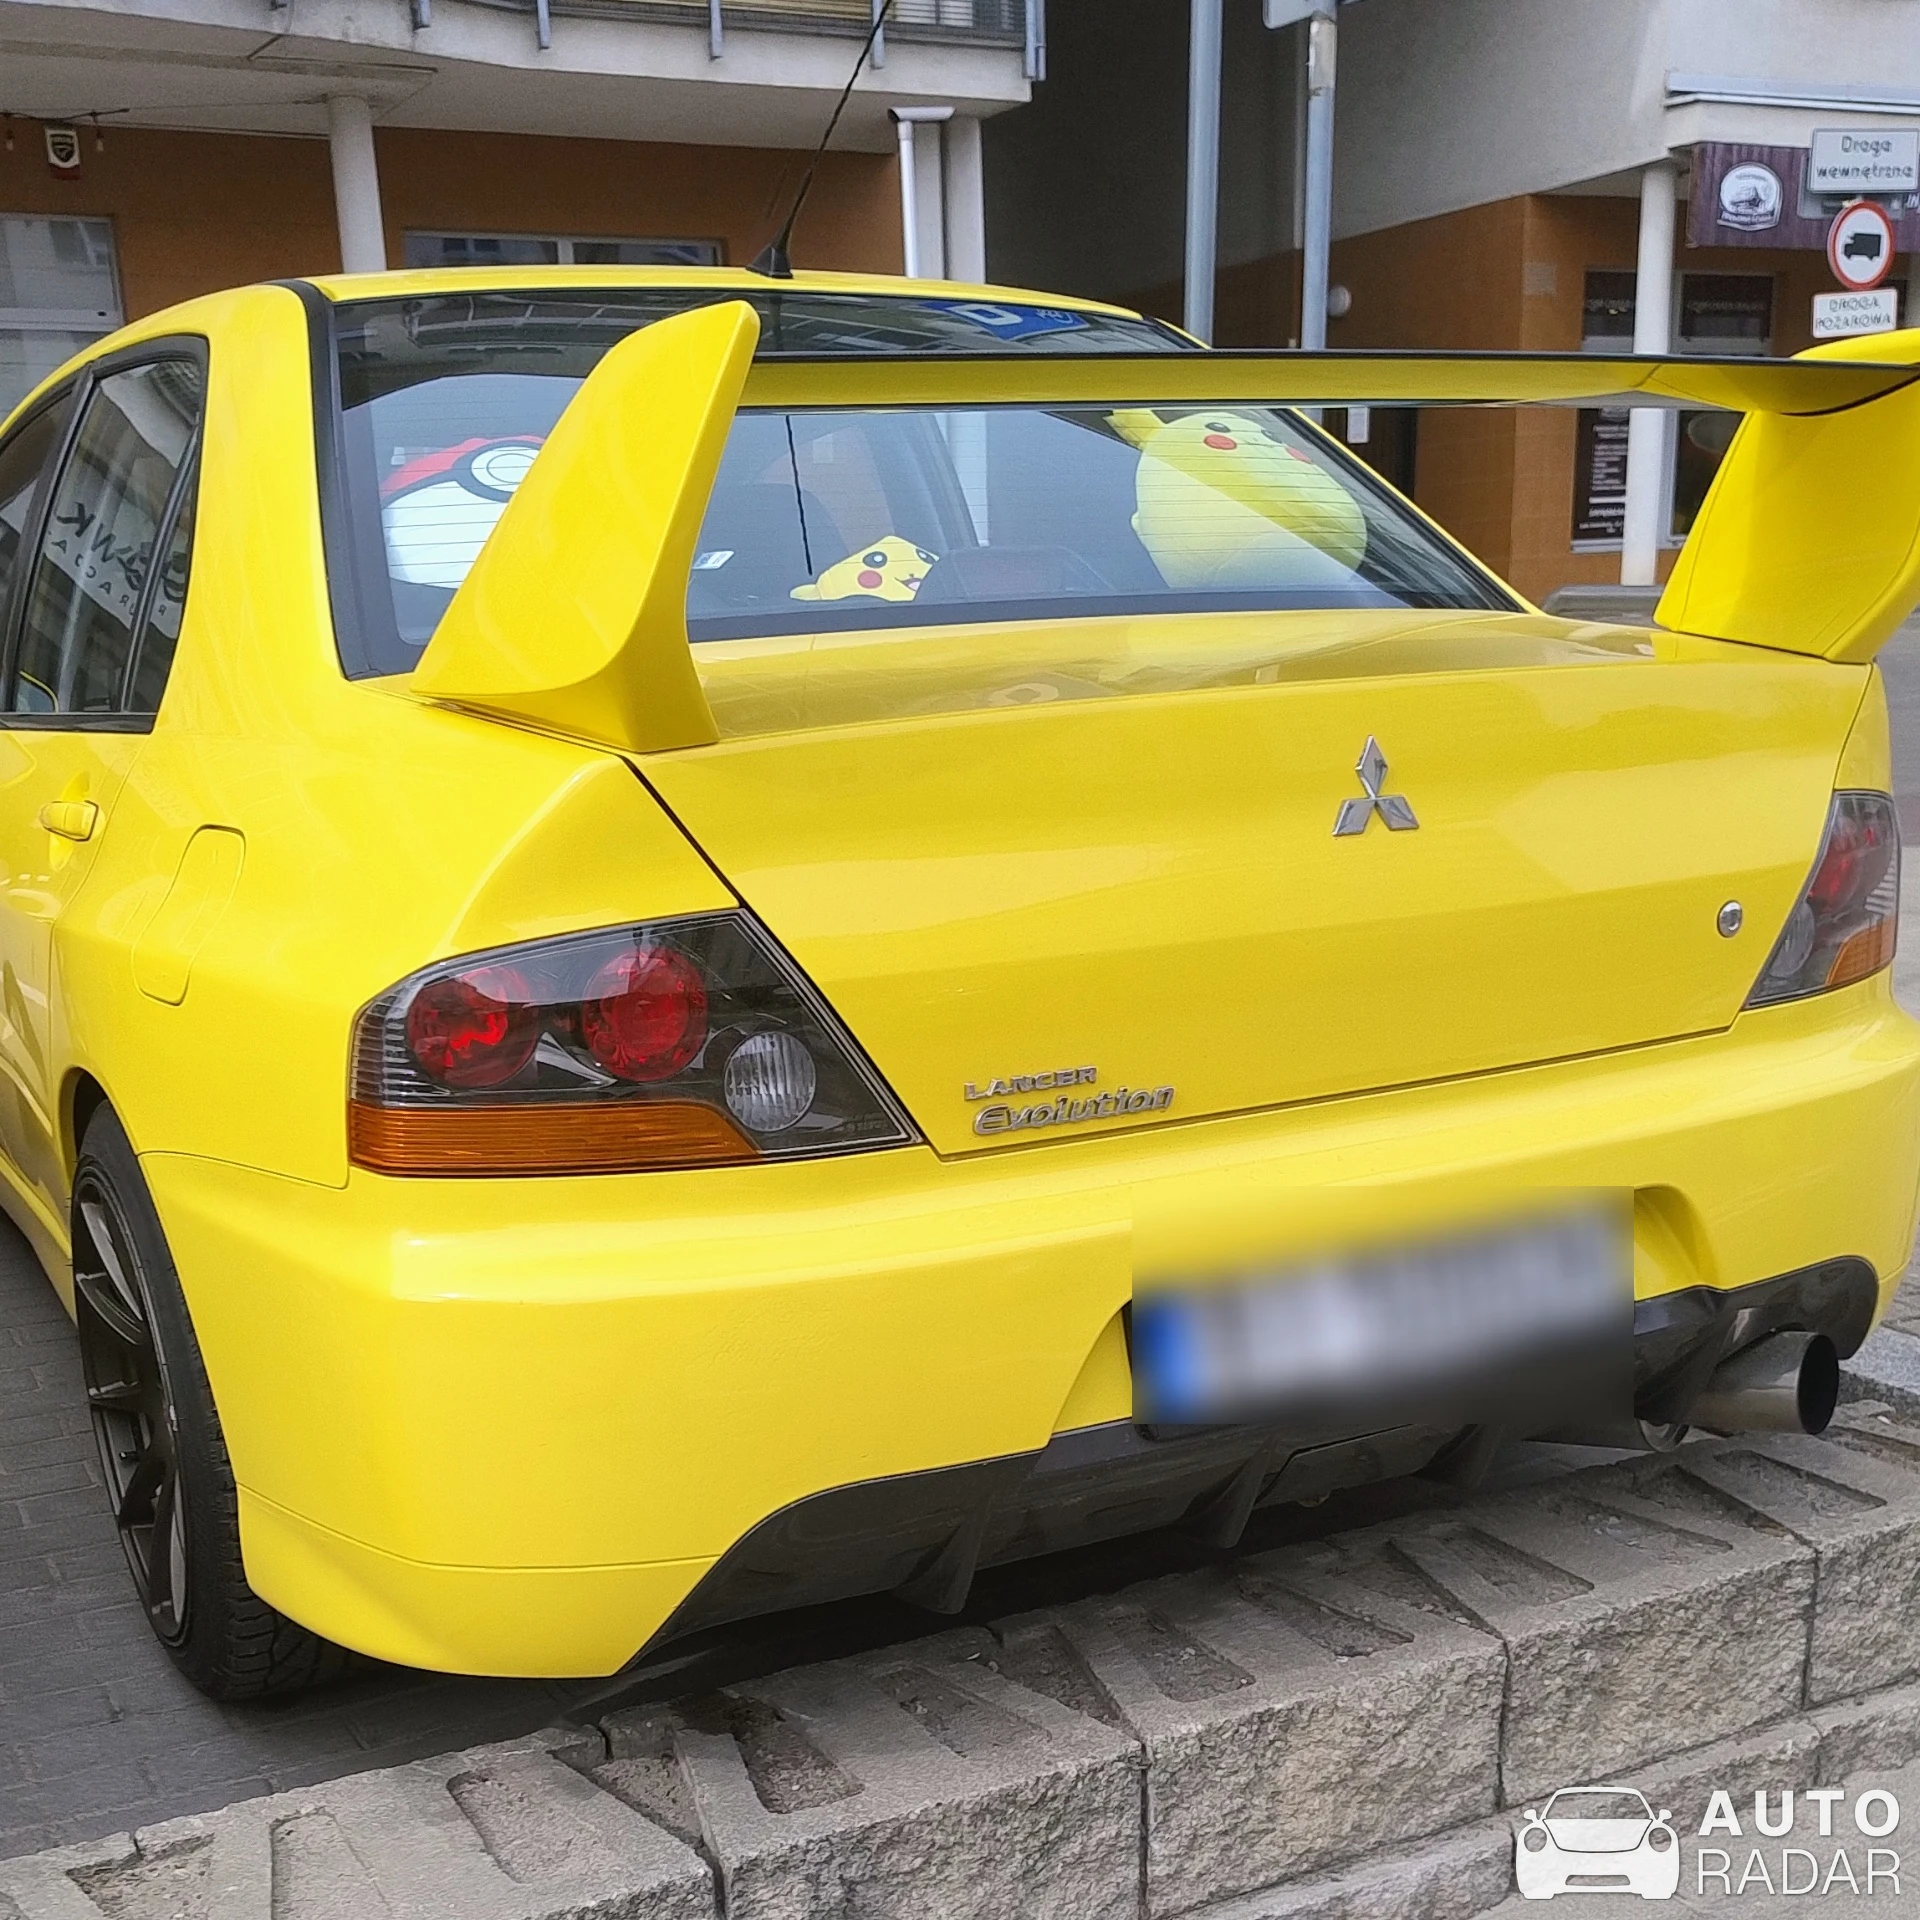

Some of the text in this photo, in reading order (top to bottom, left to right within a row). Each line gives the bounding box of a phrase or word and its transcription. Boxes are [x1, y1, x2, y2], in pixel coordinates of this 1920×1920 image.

[1841, 135, 1890, 157] Droga
[963, 1066, 1098, 1100] LANCER
[974, 1087, 1175, 1135] Evolution
